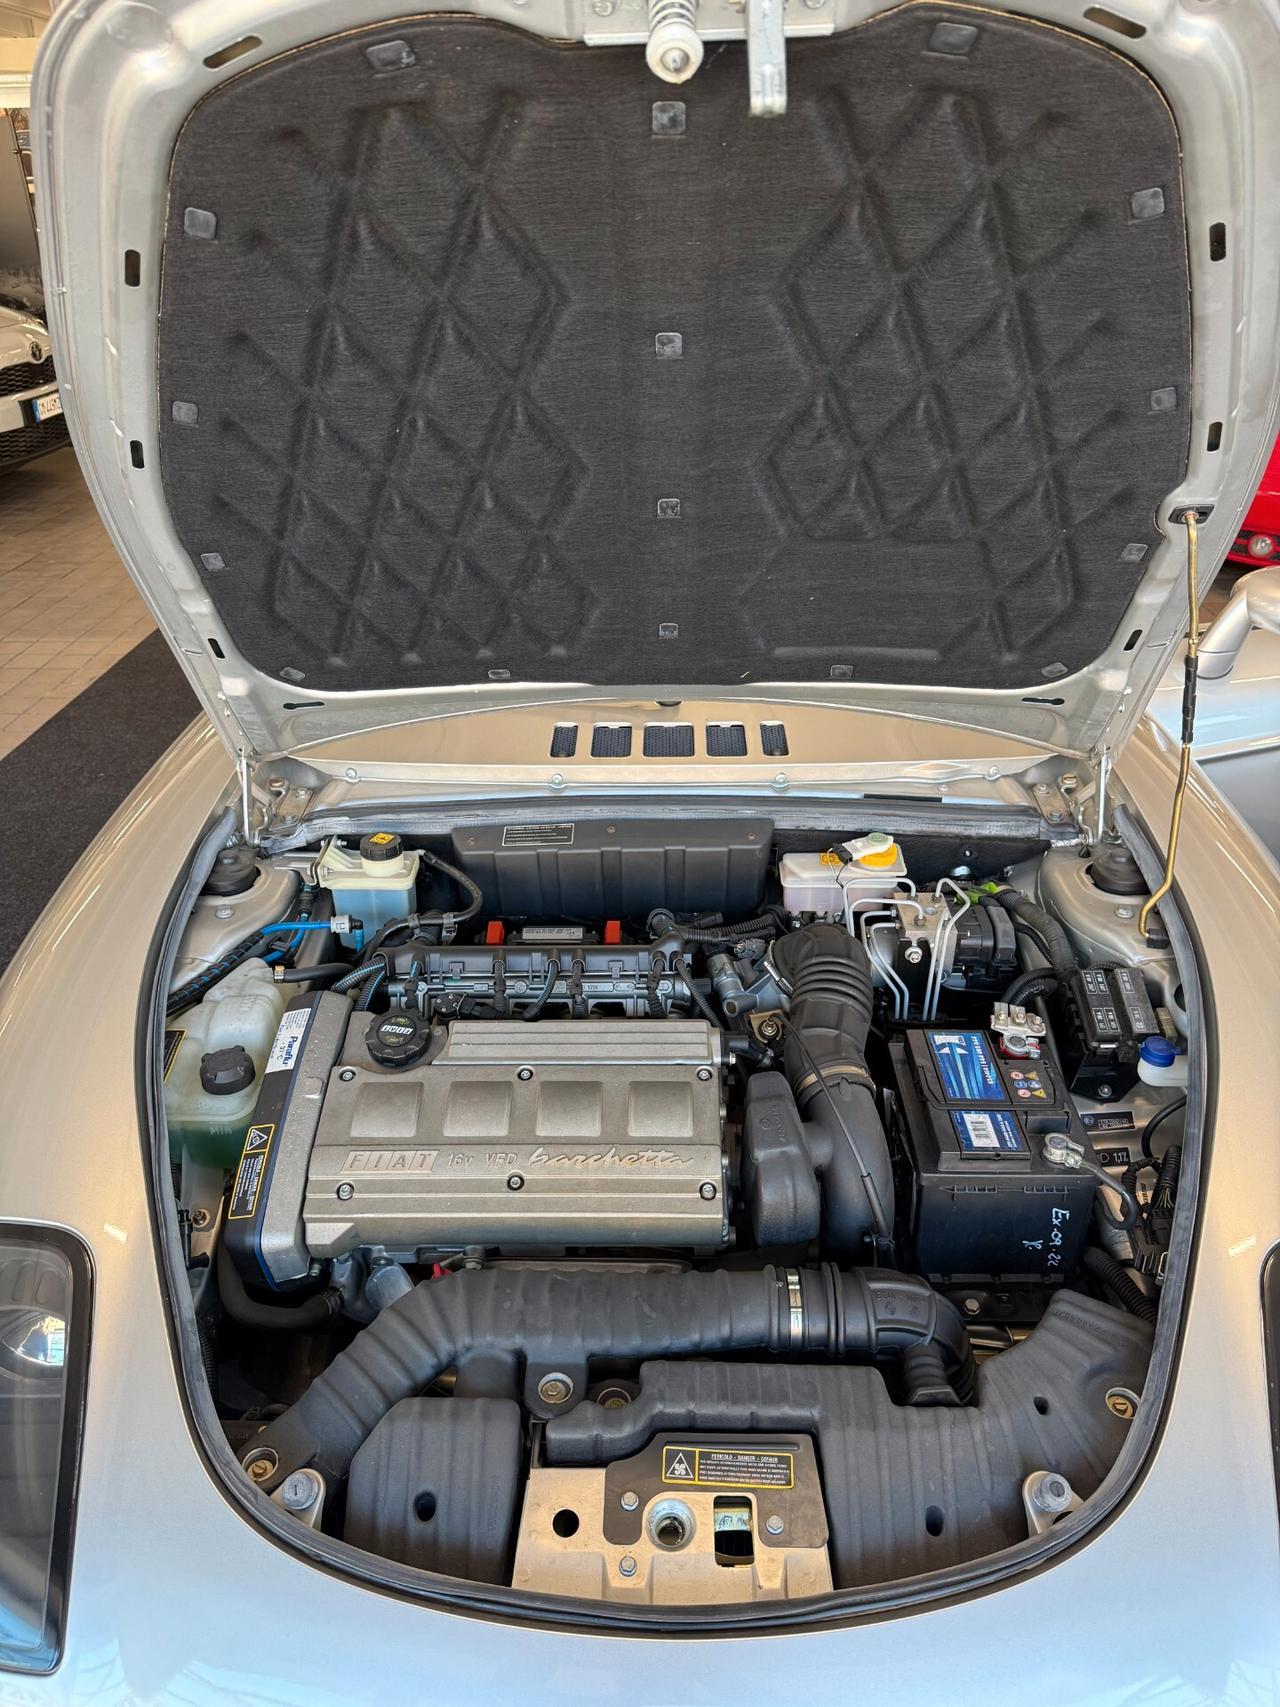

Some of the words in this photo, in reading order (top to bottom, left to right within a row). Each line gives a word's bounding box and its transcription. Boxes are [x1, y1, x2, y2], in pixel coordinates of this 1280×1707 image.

[282, 1035, 299, 1065] Paraflu
[349, 1153, 433, 1169] FIAT
[528, 1147, 695, 1168] barchetta
